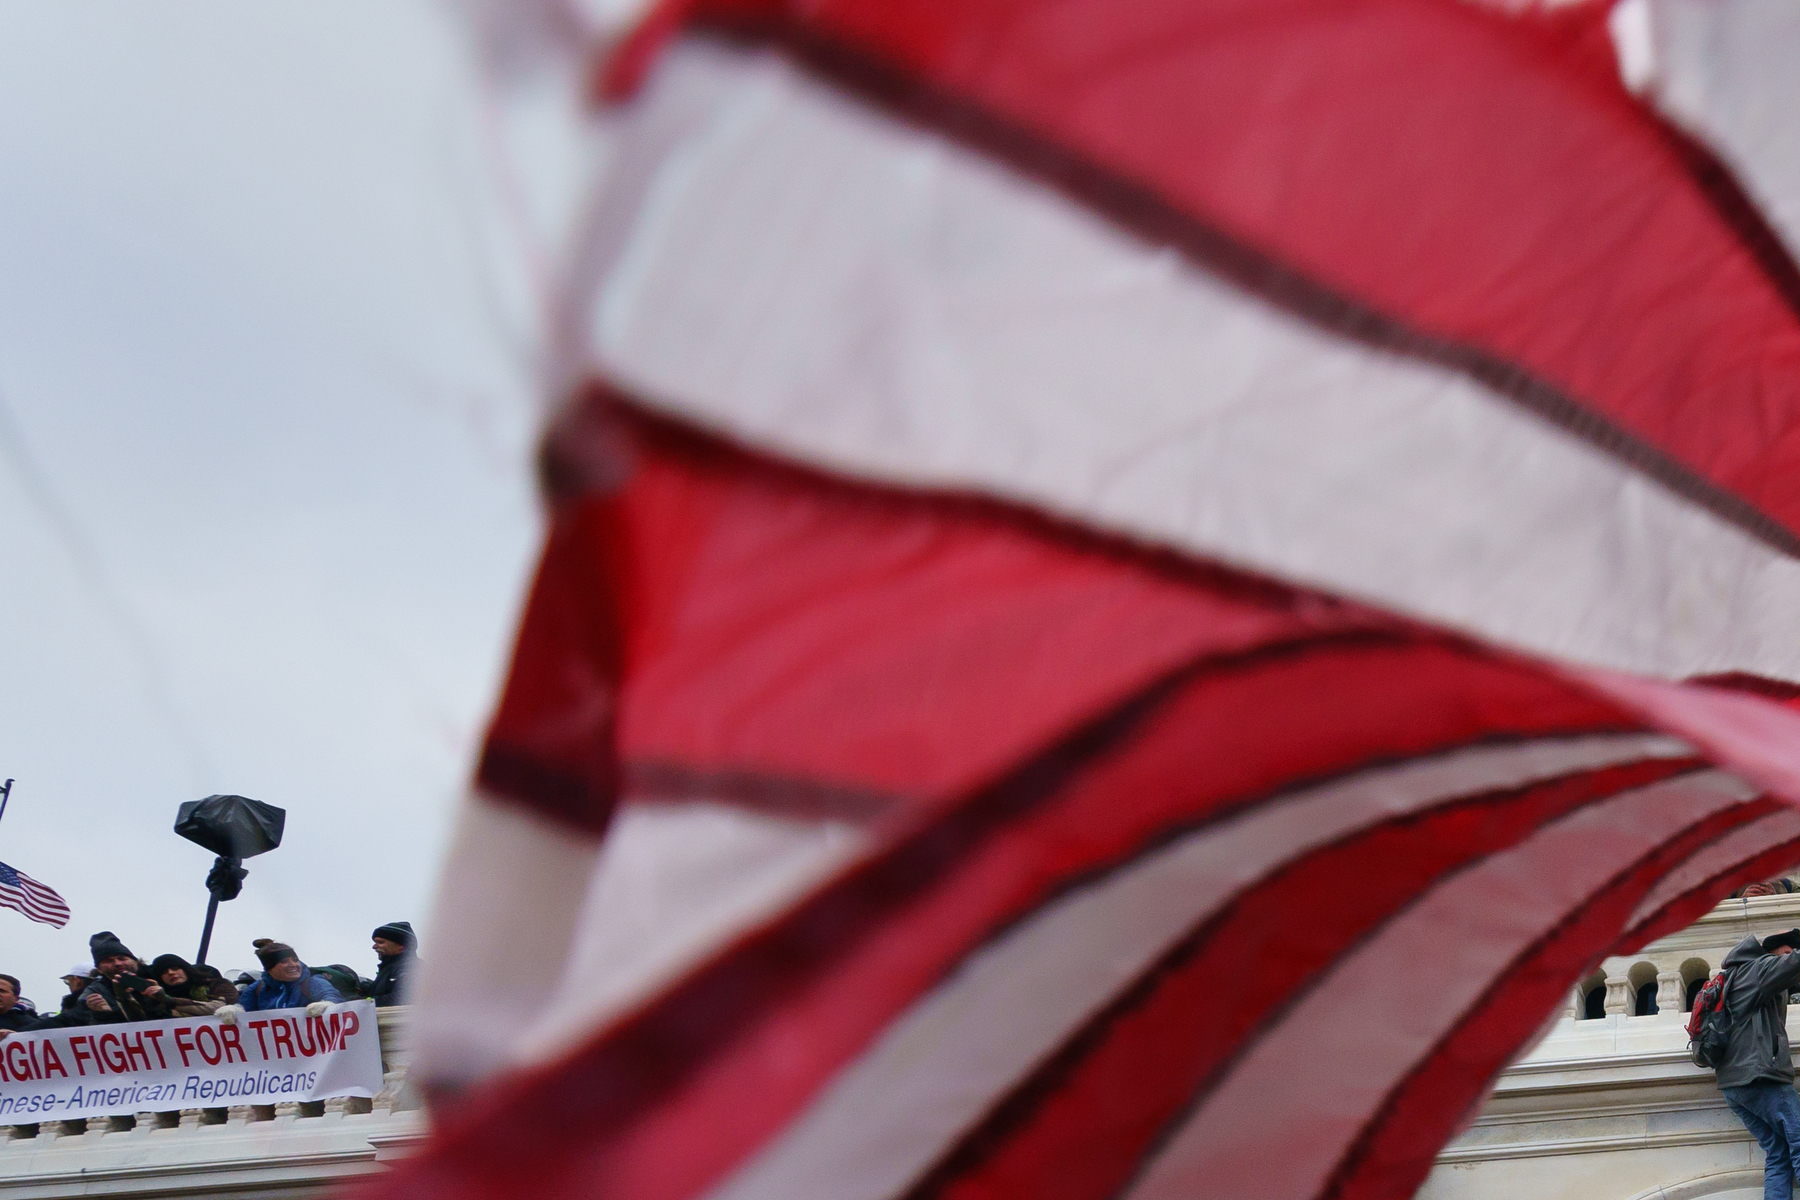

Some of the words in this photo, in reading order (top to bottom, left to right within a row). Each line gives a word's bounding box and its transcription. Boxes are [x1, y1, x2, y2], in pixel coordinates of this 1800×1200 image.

[69, 1030, 167, 1077] FIGHT
[174, 1024, 248, 1068] FOR
[248, 1010, 360, 1061] TRUMP
[181, 1070, 317, 1104] Republicans
